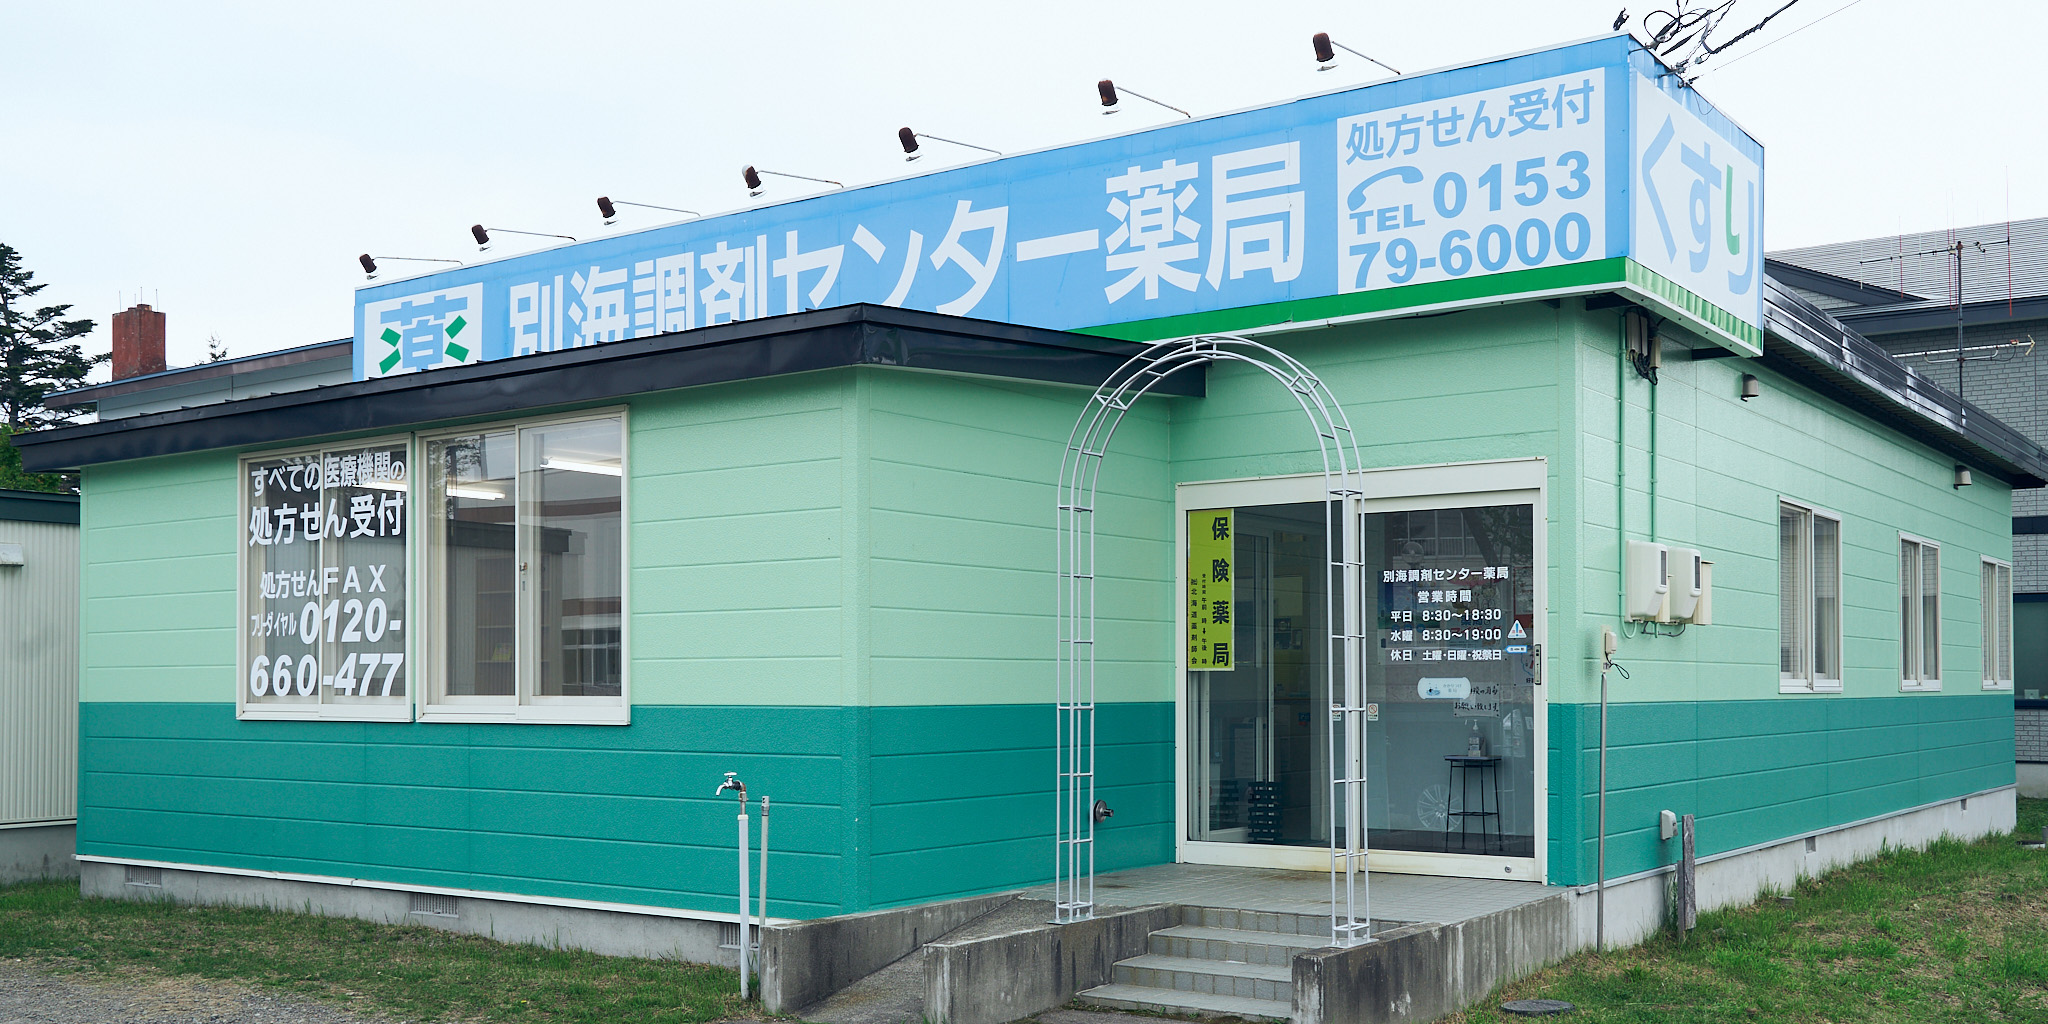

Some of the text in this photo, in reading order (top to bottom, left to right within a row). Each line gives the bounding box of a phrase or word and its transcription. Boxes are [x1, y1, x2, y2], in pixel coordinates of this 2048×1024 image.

[1346, 79, 1595, 166] 処方せん受付
[1349, 150, 1591, 235] TEL 0153
[1641, 113, 1755, 294] くすり
[509, 140, 1305, 357] 別海調剤センター薬局
[1349, 211, 1591, 289] 79-6000
[251, 451, 406, 497] すべての医療機関の
[248, 492, 404, 547] 処方せん受付
[1212, 516, 1230, 667] 保険薬局
[1383, 566, 1509, 583] 別海調剤センター薬局
[1417, 590, 1472, 604] 営業時間
[300, 598, 402, 645] 0120-
[1390, 610, 1413, 622] 平日
[1390, 630, 1413, 642] 水曜
[250, 652, 405, 697] 660-477
[1390, 650, 1413, 661] 休日
